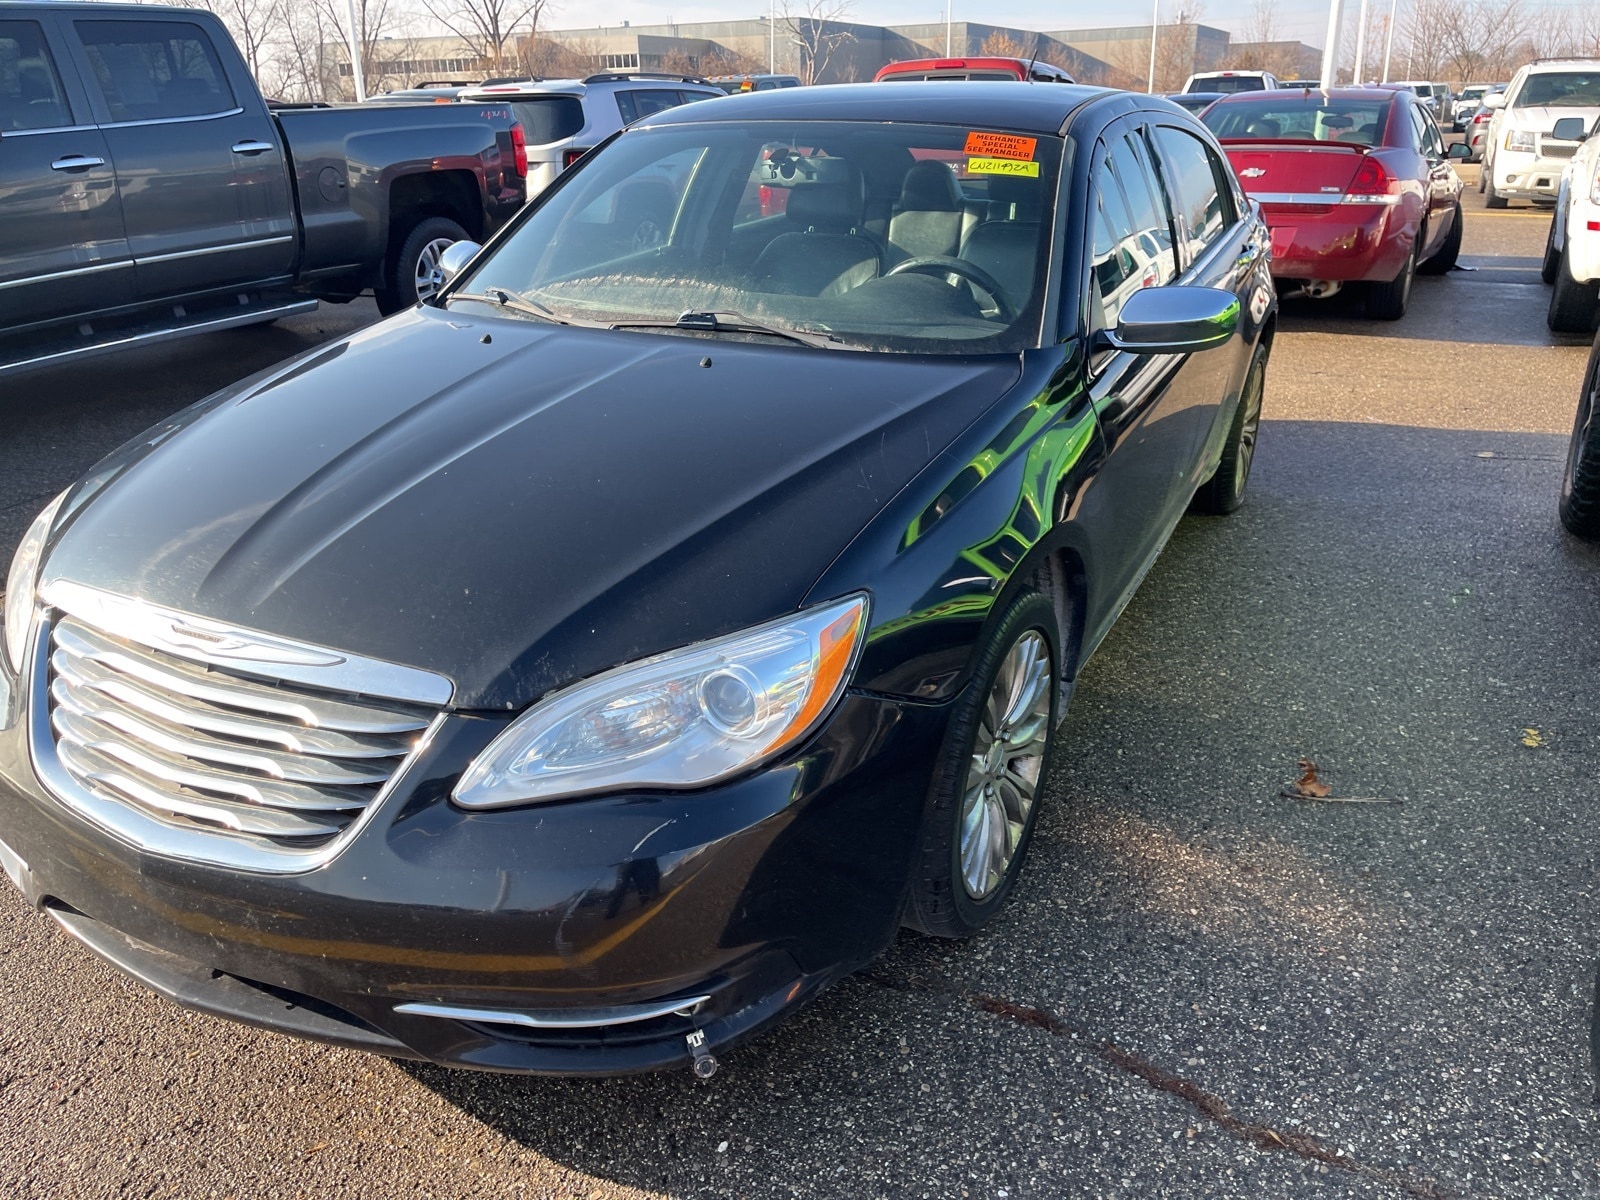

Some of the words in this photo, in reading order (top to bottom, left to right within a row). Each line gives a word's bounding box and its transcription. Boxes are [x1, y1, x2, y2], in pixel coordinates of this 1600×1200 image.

[976, 134, 1027, 144] MECHANICS
[982, 140, 1018, 150] SPECIAL
[967, 145, 984, 153] SEE
[985, 147, 1030, 158] MANAGER
